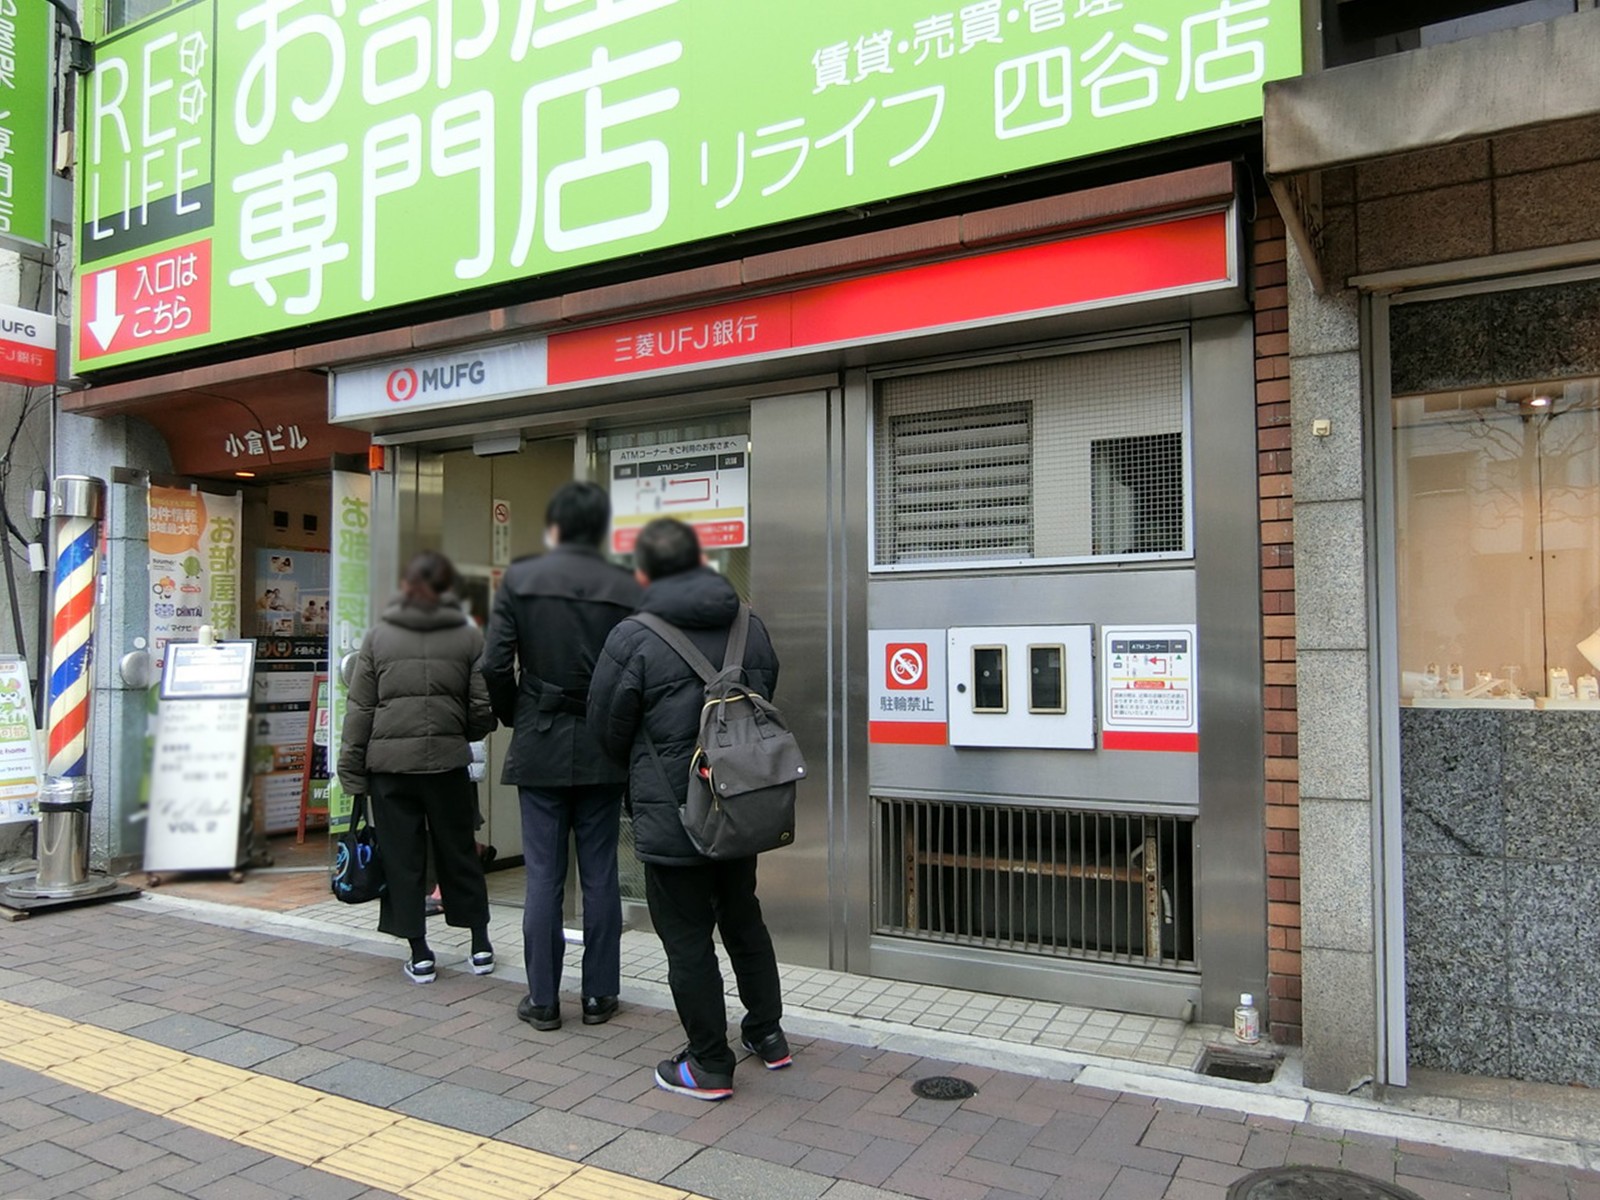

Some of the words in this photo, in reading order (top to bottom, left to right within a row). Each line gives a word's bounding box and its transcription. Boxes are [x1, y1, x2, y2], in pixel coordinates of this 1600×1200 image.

[93, 31, 178, 165] RE
[700, 84, 946, 210] リライフ
[993, 0, 1270, 140] 四谷店
[93, 136, 201, 241] LIFE
[228, 40, 683, 315] 専門店
[133, 252, 198, 300] 入口は
[0, 318, 37, 338] UFG
[132, 296, 192, 339] こちら
[614, 314, 760, 362] 三菱UFJ銀行
[421, 360, 486, 394] MUFG
[225, 424, 308, 458] 小倉ビル
[620, 440, 738, 461] ATMコーナーをご利用のお客さまへ
[208, 516, 237, 632] お部屋探
[879, 696, 935, 713] 駐輪禁止
